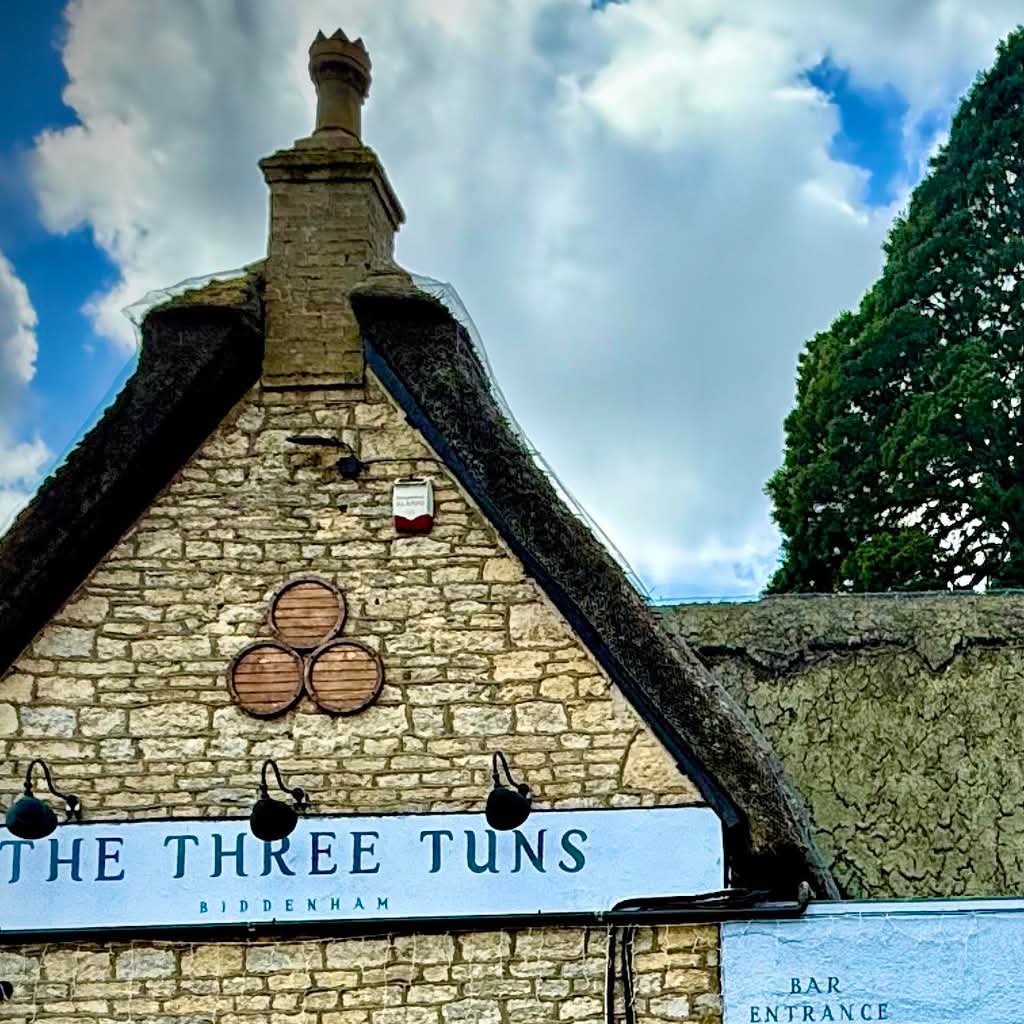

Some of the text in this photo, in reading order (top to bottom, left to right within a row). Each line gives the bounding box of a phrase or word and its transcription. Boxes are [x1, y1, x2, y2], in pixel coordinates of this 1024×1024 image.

[0, 828, 589, 884] THE THREE TUNS
[199, 897, 390, 914] BIDDENHAM
[789, 976, 843, 995] BAR
[749, 1003, 890, 1024] ENTRANCE
